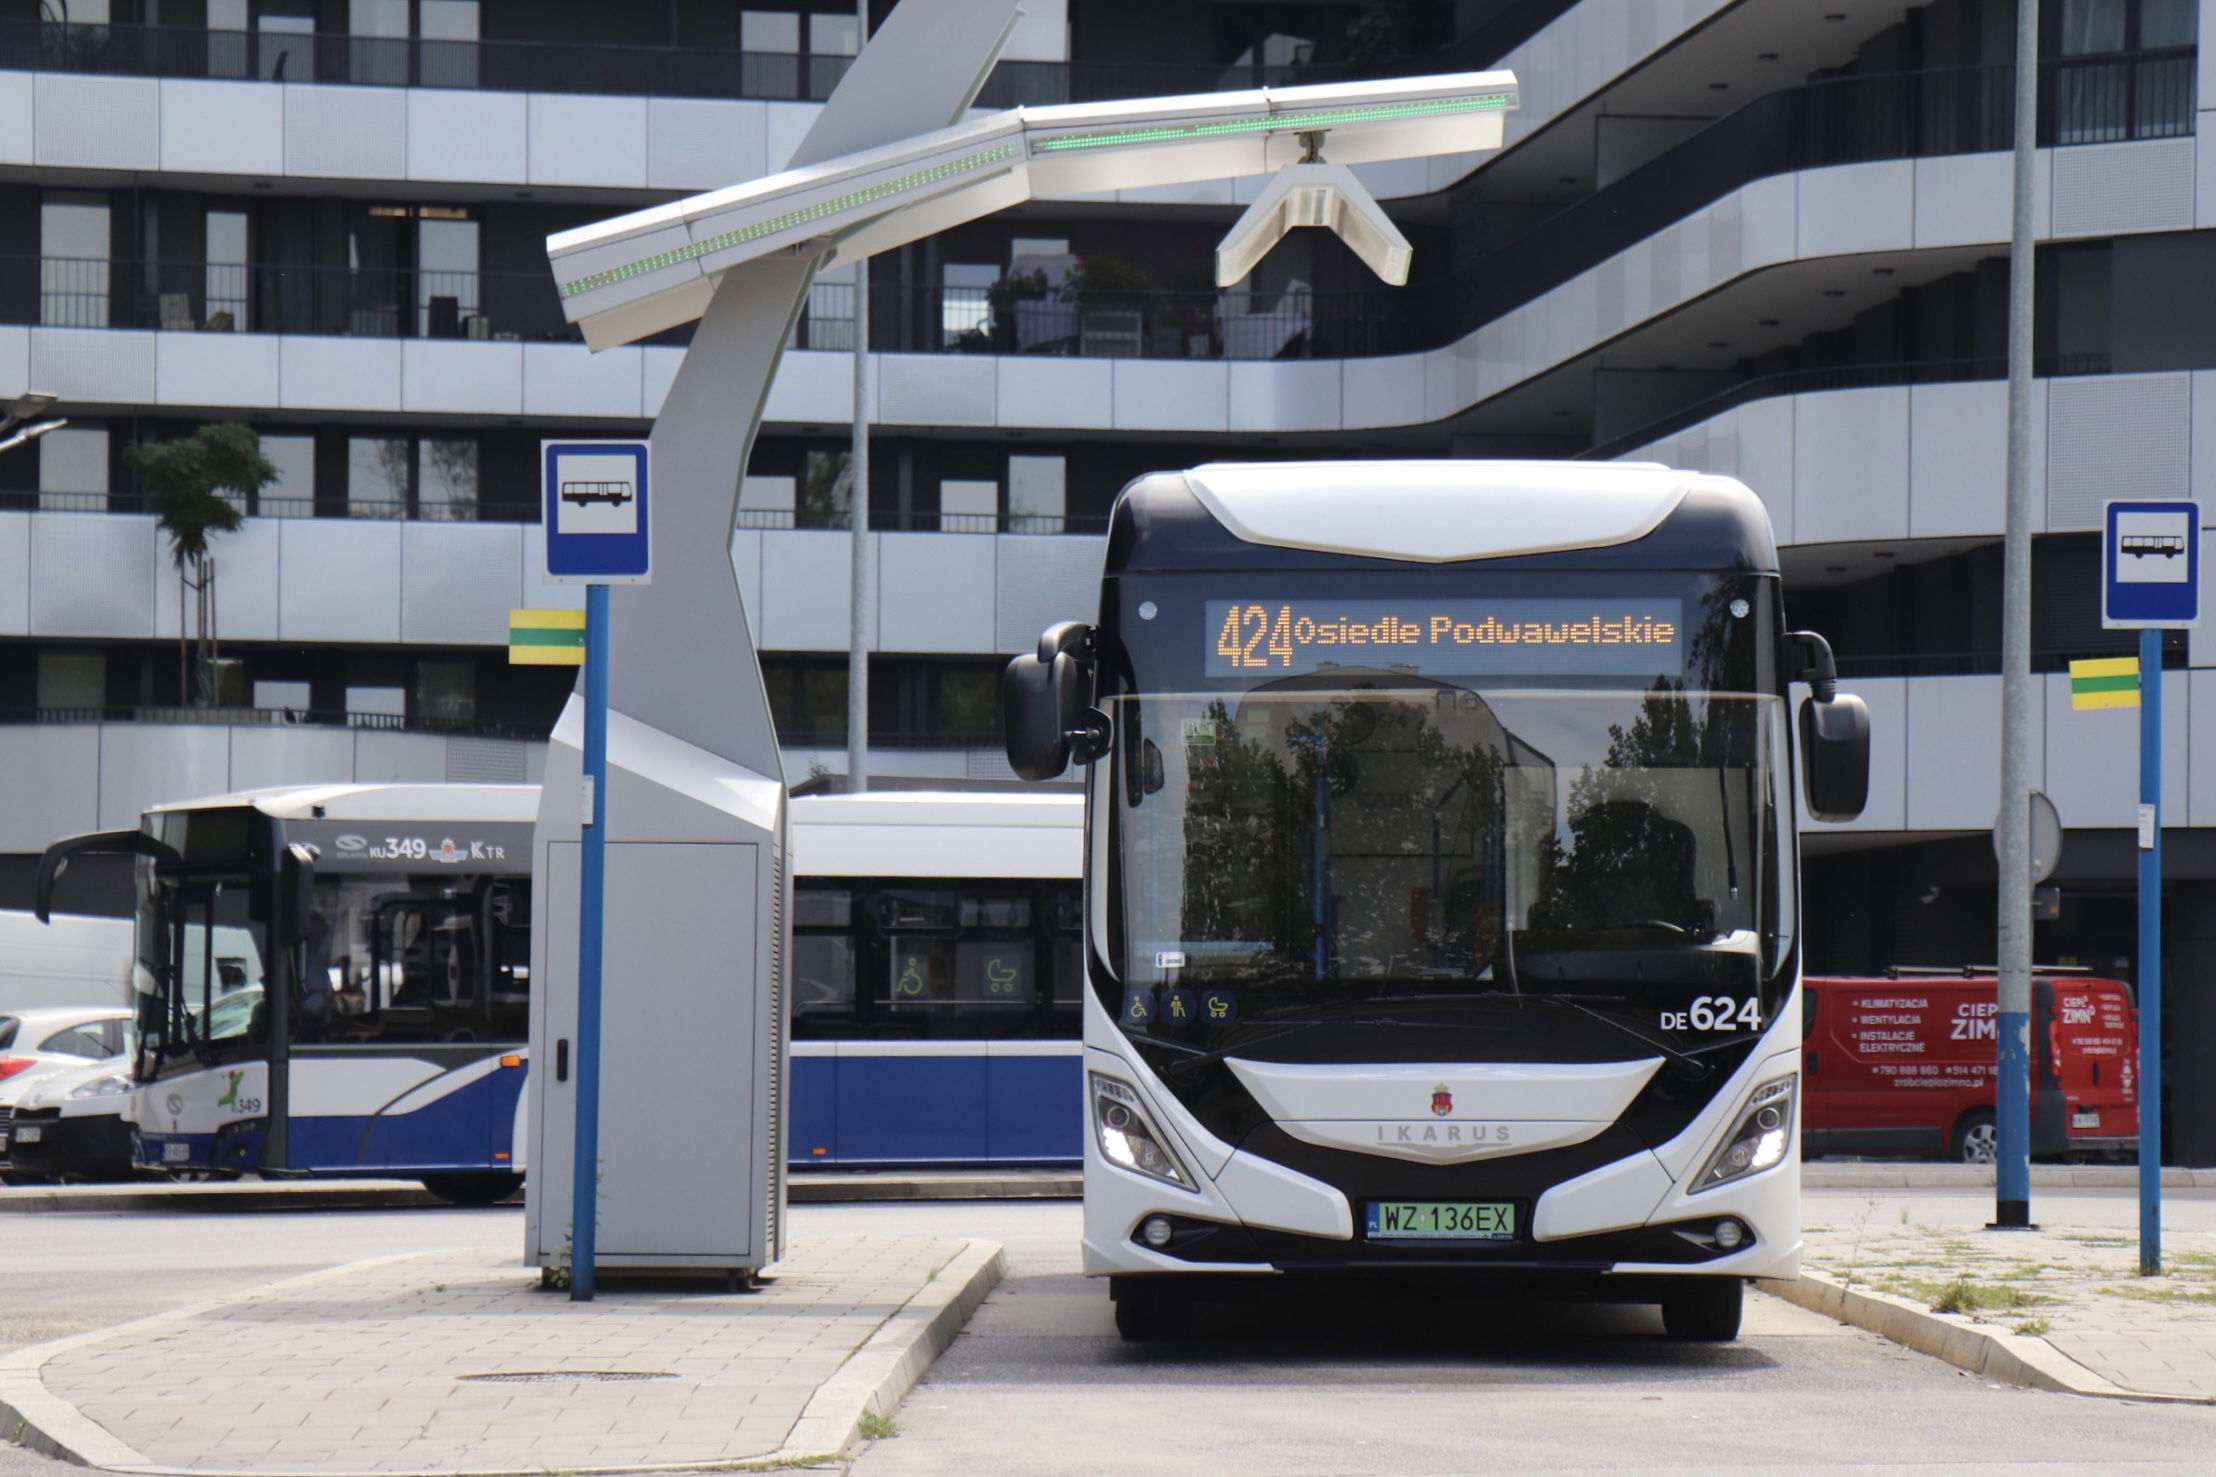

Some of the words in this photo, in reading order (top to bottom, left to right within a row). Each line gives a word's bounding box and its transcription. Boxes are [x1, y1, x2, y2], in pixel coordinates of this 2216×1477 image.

[1218, 605, 1293, 667] 424
[1294, 616, 1421, 644] Osiedle
[1430, 615, 1676, 644] Podwawelskie
[1860, 999, 1928, 1008] KLIMATYZACJA
[1957, 1003, 1999, 1017] CIEP
[1860, 1015, 1921, 1024] WENTYLACJA
[1860, 1031, 1915, 1041] INSTALACJE
[1950, 1019, 1999, 1039] ZIM
[1859, 1042, 1926, 1052] ELEKTRYCZNE
[1377, 1125, 1510, 1141] IKARUS
[1385, 1206, 1418, 1231] WZ
[1430, 1206, 1508, 1231] 136EX
